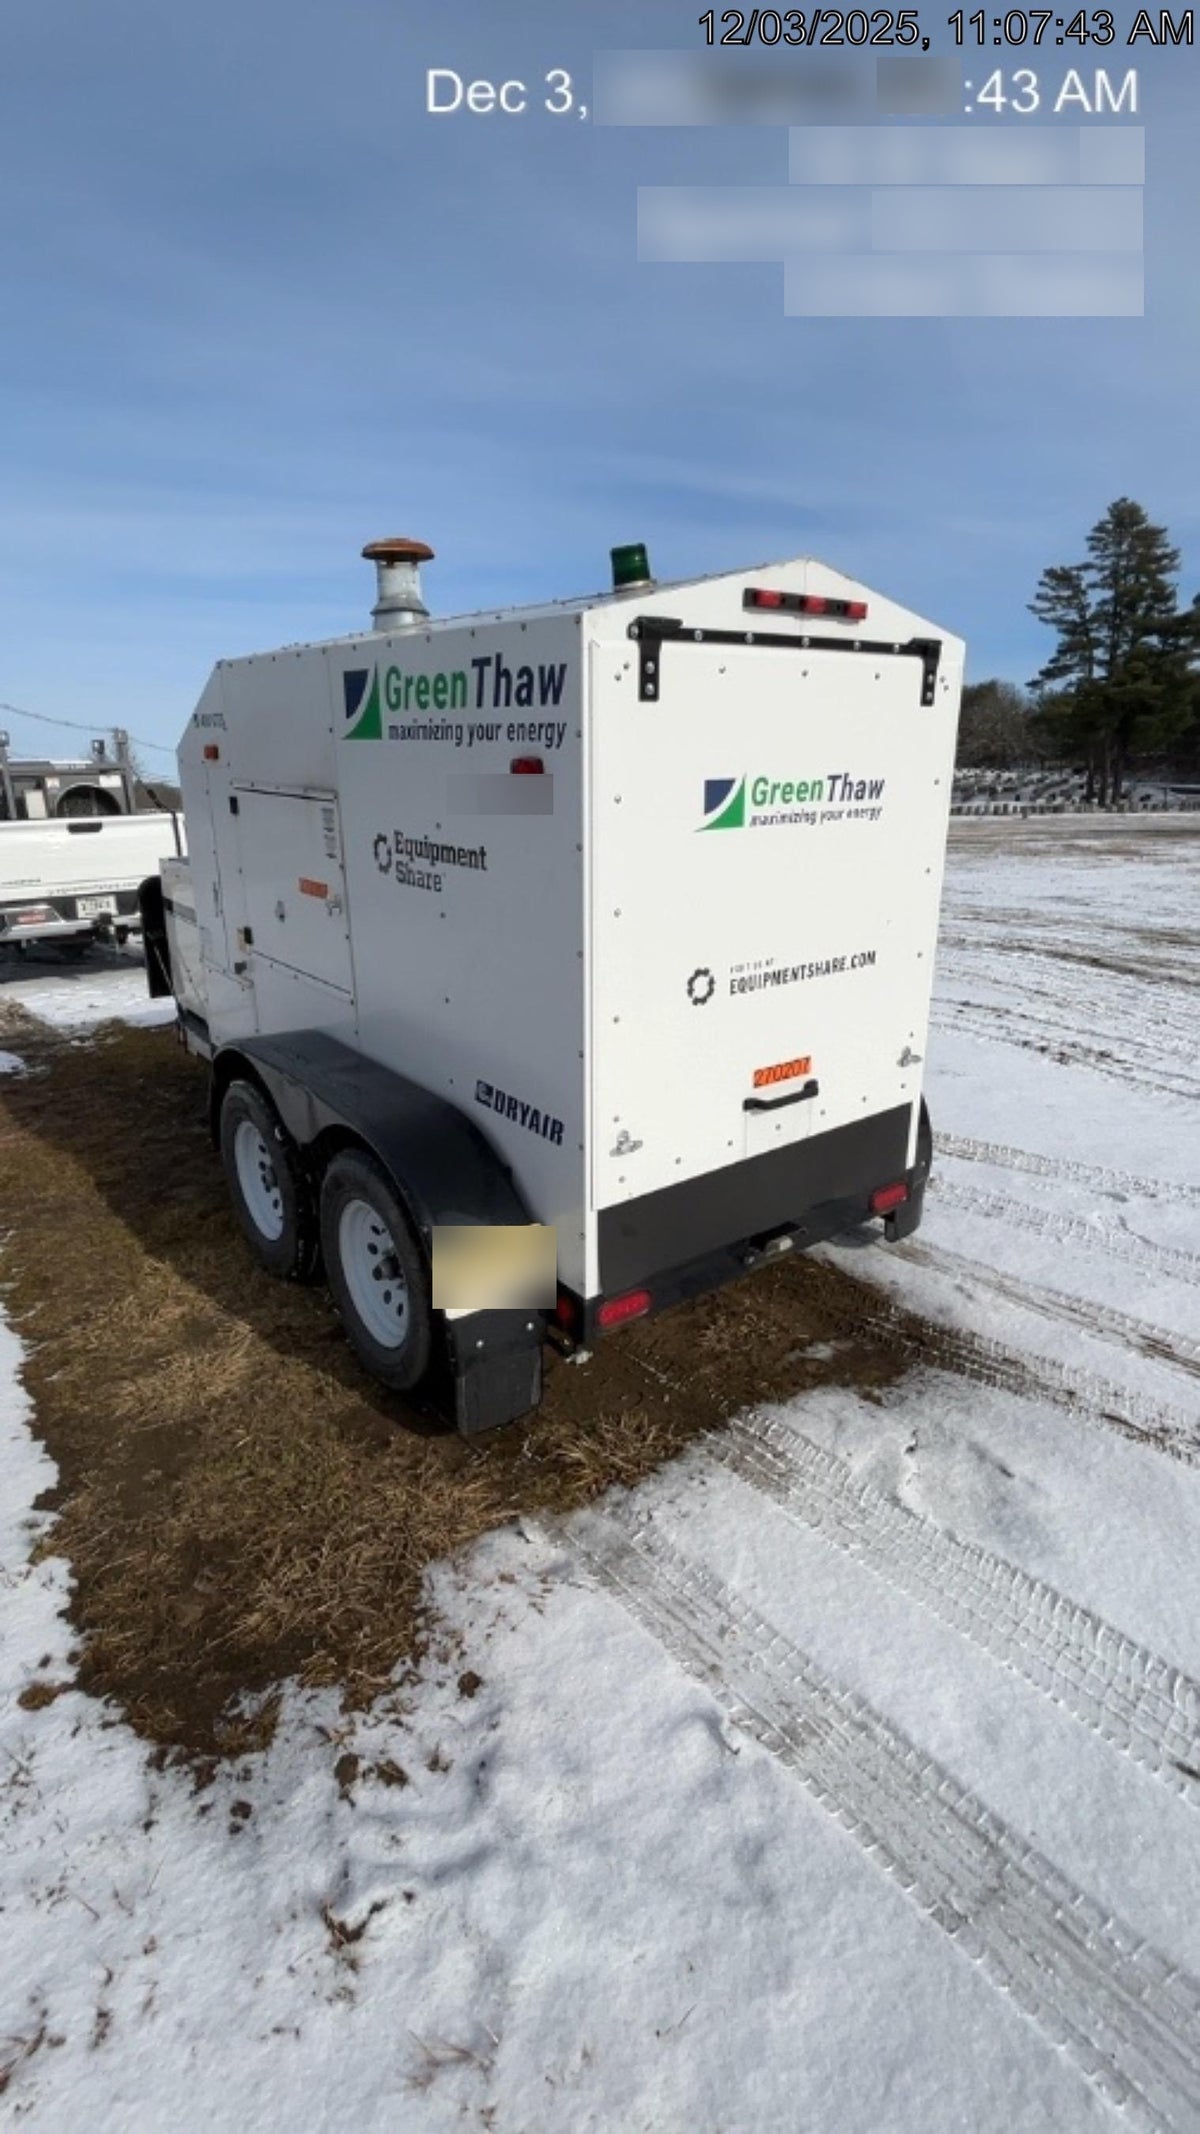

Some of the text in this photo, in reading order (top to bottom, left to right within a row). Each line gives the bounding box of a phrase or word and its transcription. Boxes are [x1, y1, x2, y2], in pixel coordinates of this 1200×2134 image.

[388, 718, 567, 749] maximizing your energy
[749, 806, 882, 827] maximizing your energy
[393, 829, 488, 871] Equipment
[395, 860, 442, 893] Share
[730, 950, 876, 996] EQUIPMENTSHARE.COM
[494, 1087, 565, 1146] DRYAIR
